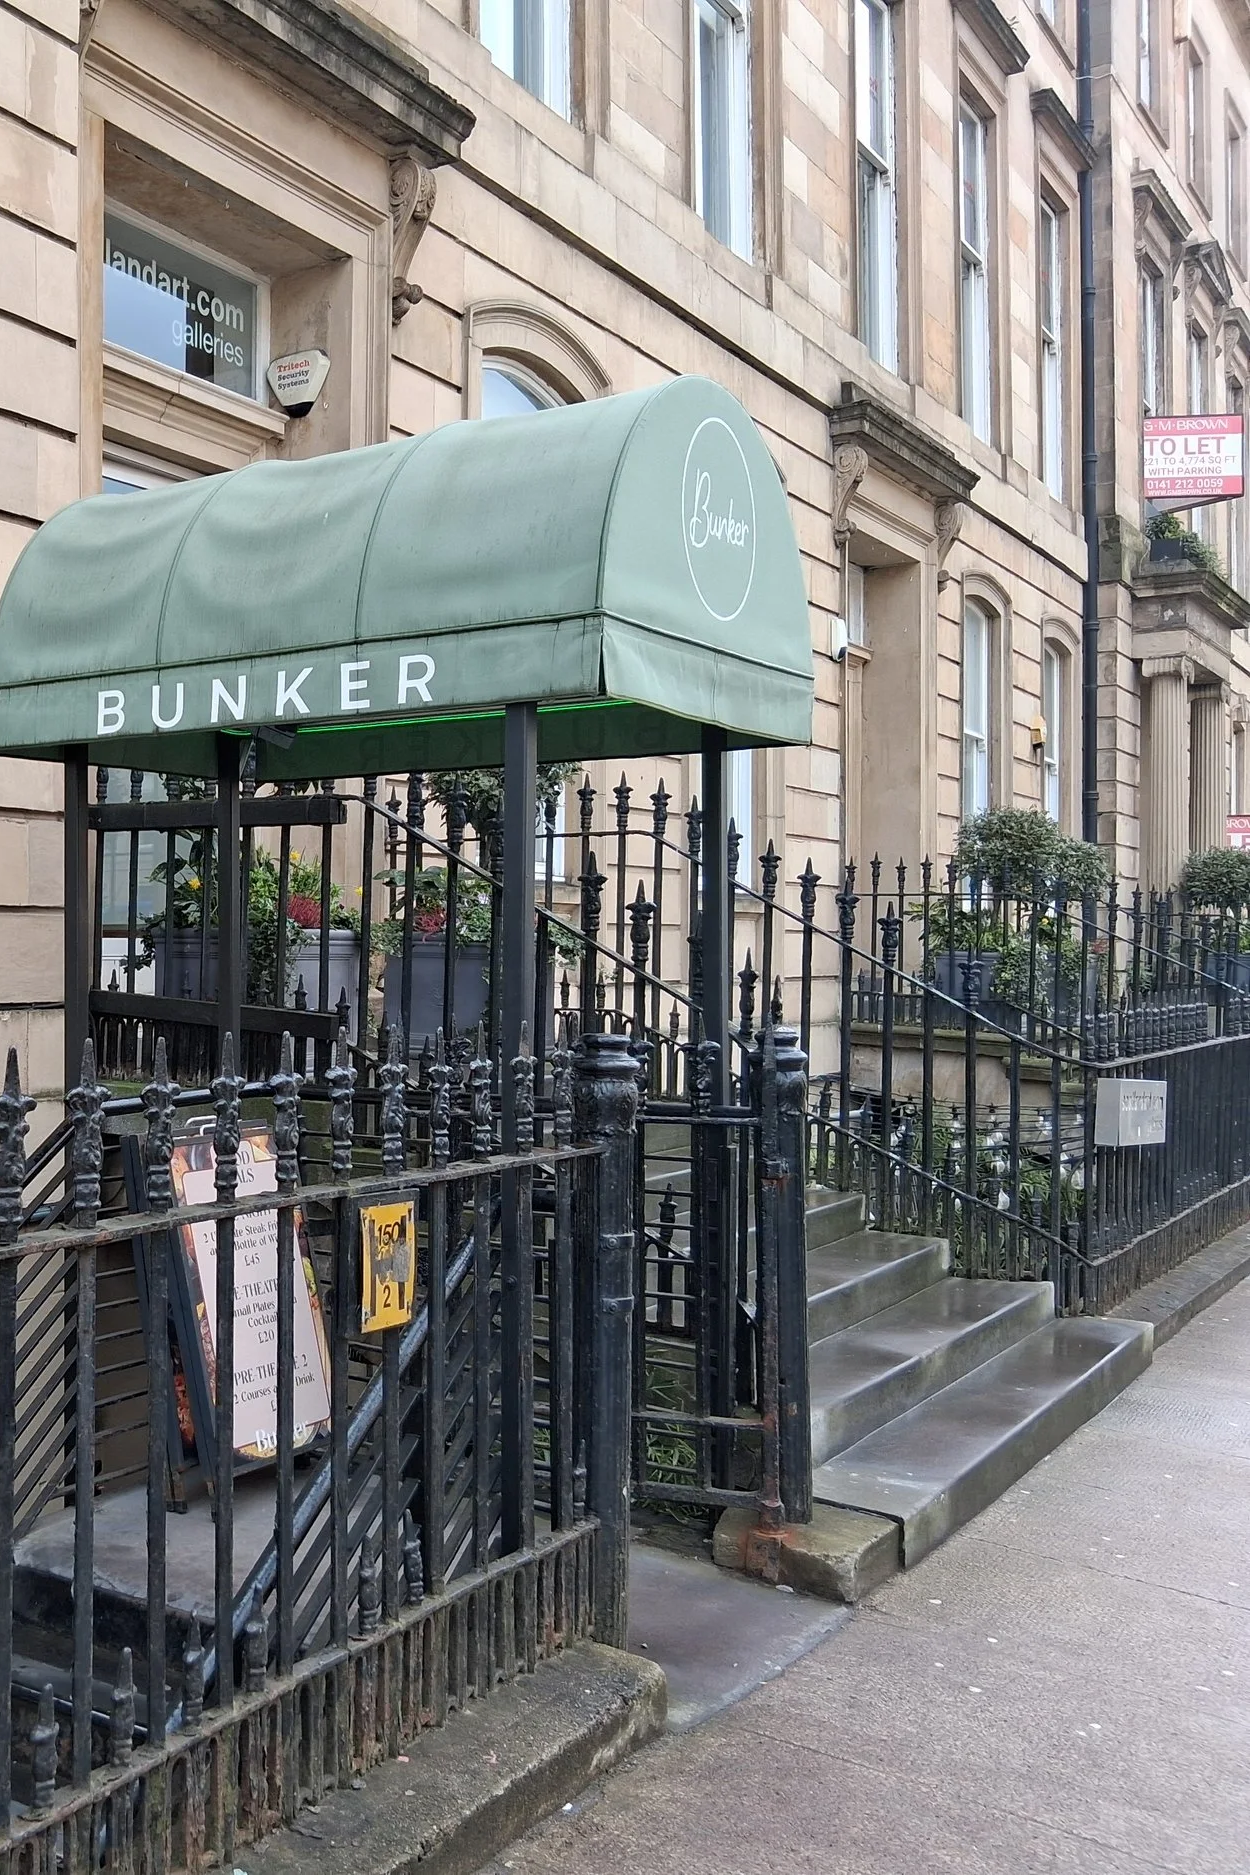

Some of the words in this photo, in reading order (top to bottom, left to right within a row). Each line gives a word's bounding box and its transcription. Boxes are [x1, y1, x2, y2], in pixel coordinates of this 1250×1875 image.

[172, 320, 244, 367] galleries
[277, 360, 310, 373] Tritech
[277, 370, 310, 382] Security
[277, 379, 309, 390] Systems
[1144, 437, 1176, 456] TO
[1184, 436, 1226, 455] LET
[1163, 457, 1176, 465] TO
[1179, 456, 1205, 466] 4,774
[1208, 456, 1222, 464] SQ
[1225, 455, 1237, 463] FT
[1148, 467, 1174, 476] WITH
[1177, 466, 1222, 475] PARKING
[1147, 480, 1170, 489] 0141
[1175, 479, 1193, 488] 212
[1197, 478, 1223, 488] 0059
[690, 468, 749, 548] Bunker
[97, 654, 436, 735] BUNKER
[245, 1222, 267, 1236] Steak
[378, 1221, 401, 1246] 150
[234, 1238, 258, 1251] Bottle
[259, 1235, 267, 1247] of
[244, 1252, 260, 1267] £45
[383, 1284, 391, 1308] 2
[234, 1304, 251, 1317] mall
[252, 1301, 275, 1313] Plates
[258, 1329, 275, 1344] £20
[302, 1353, 308, 1367] 2
[234, 1393, 239, 1404] 2
[241, 1385, 271, 1402] Courses
[295, 1371, 315, 1387] Drink
